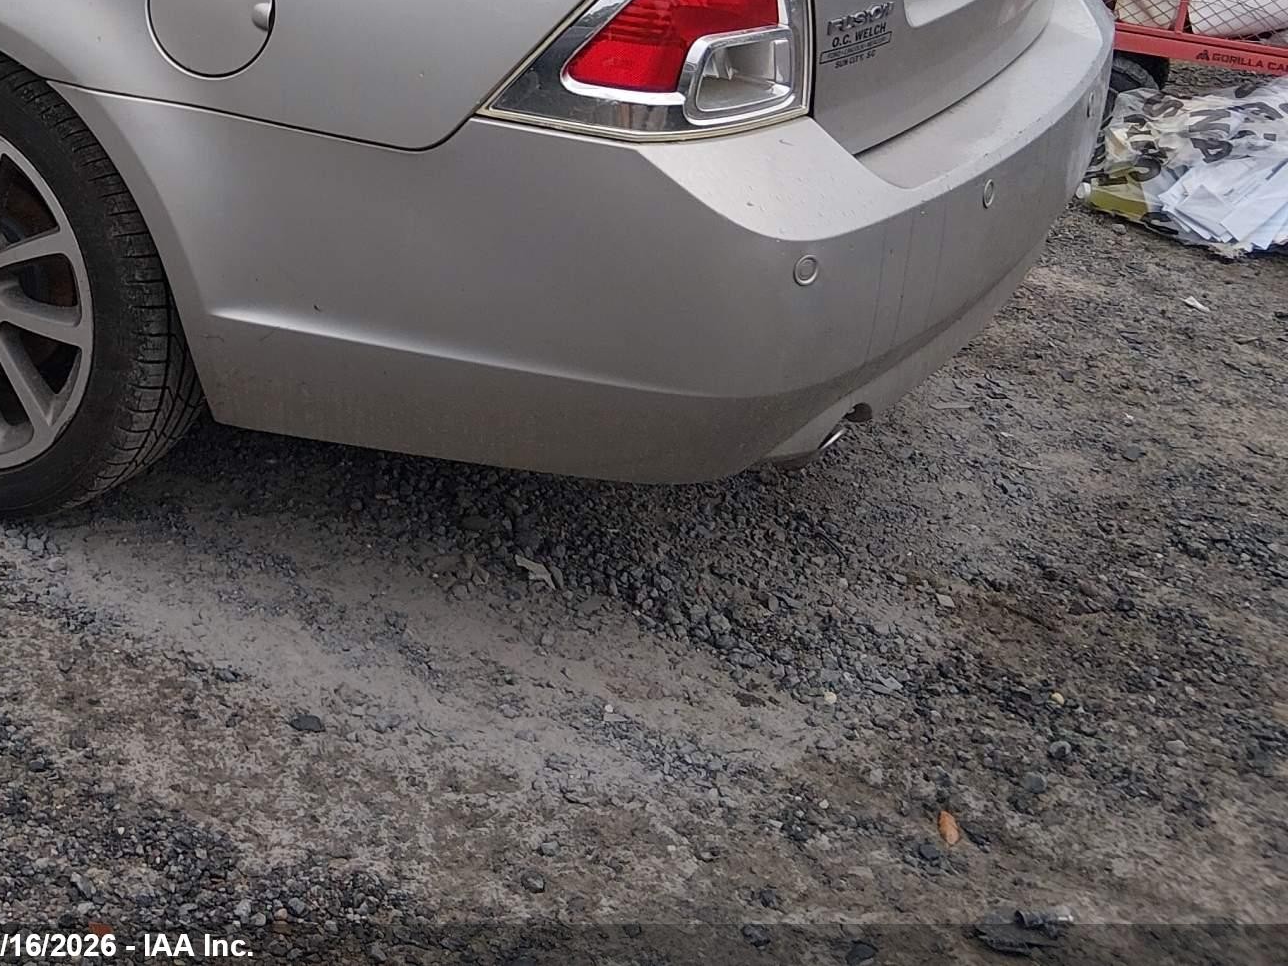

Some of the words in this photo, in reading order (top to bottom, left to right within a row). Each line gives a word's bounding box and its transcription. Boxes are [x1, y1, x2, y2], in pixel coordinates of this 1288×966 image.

[832, 34, 852, 48] O.C.
[855, 21, 887, 42] WELCH
[1212, 53, 1264, 68] GORILLA
[1267, 61, 1288, 72] CA
